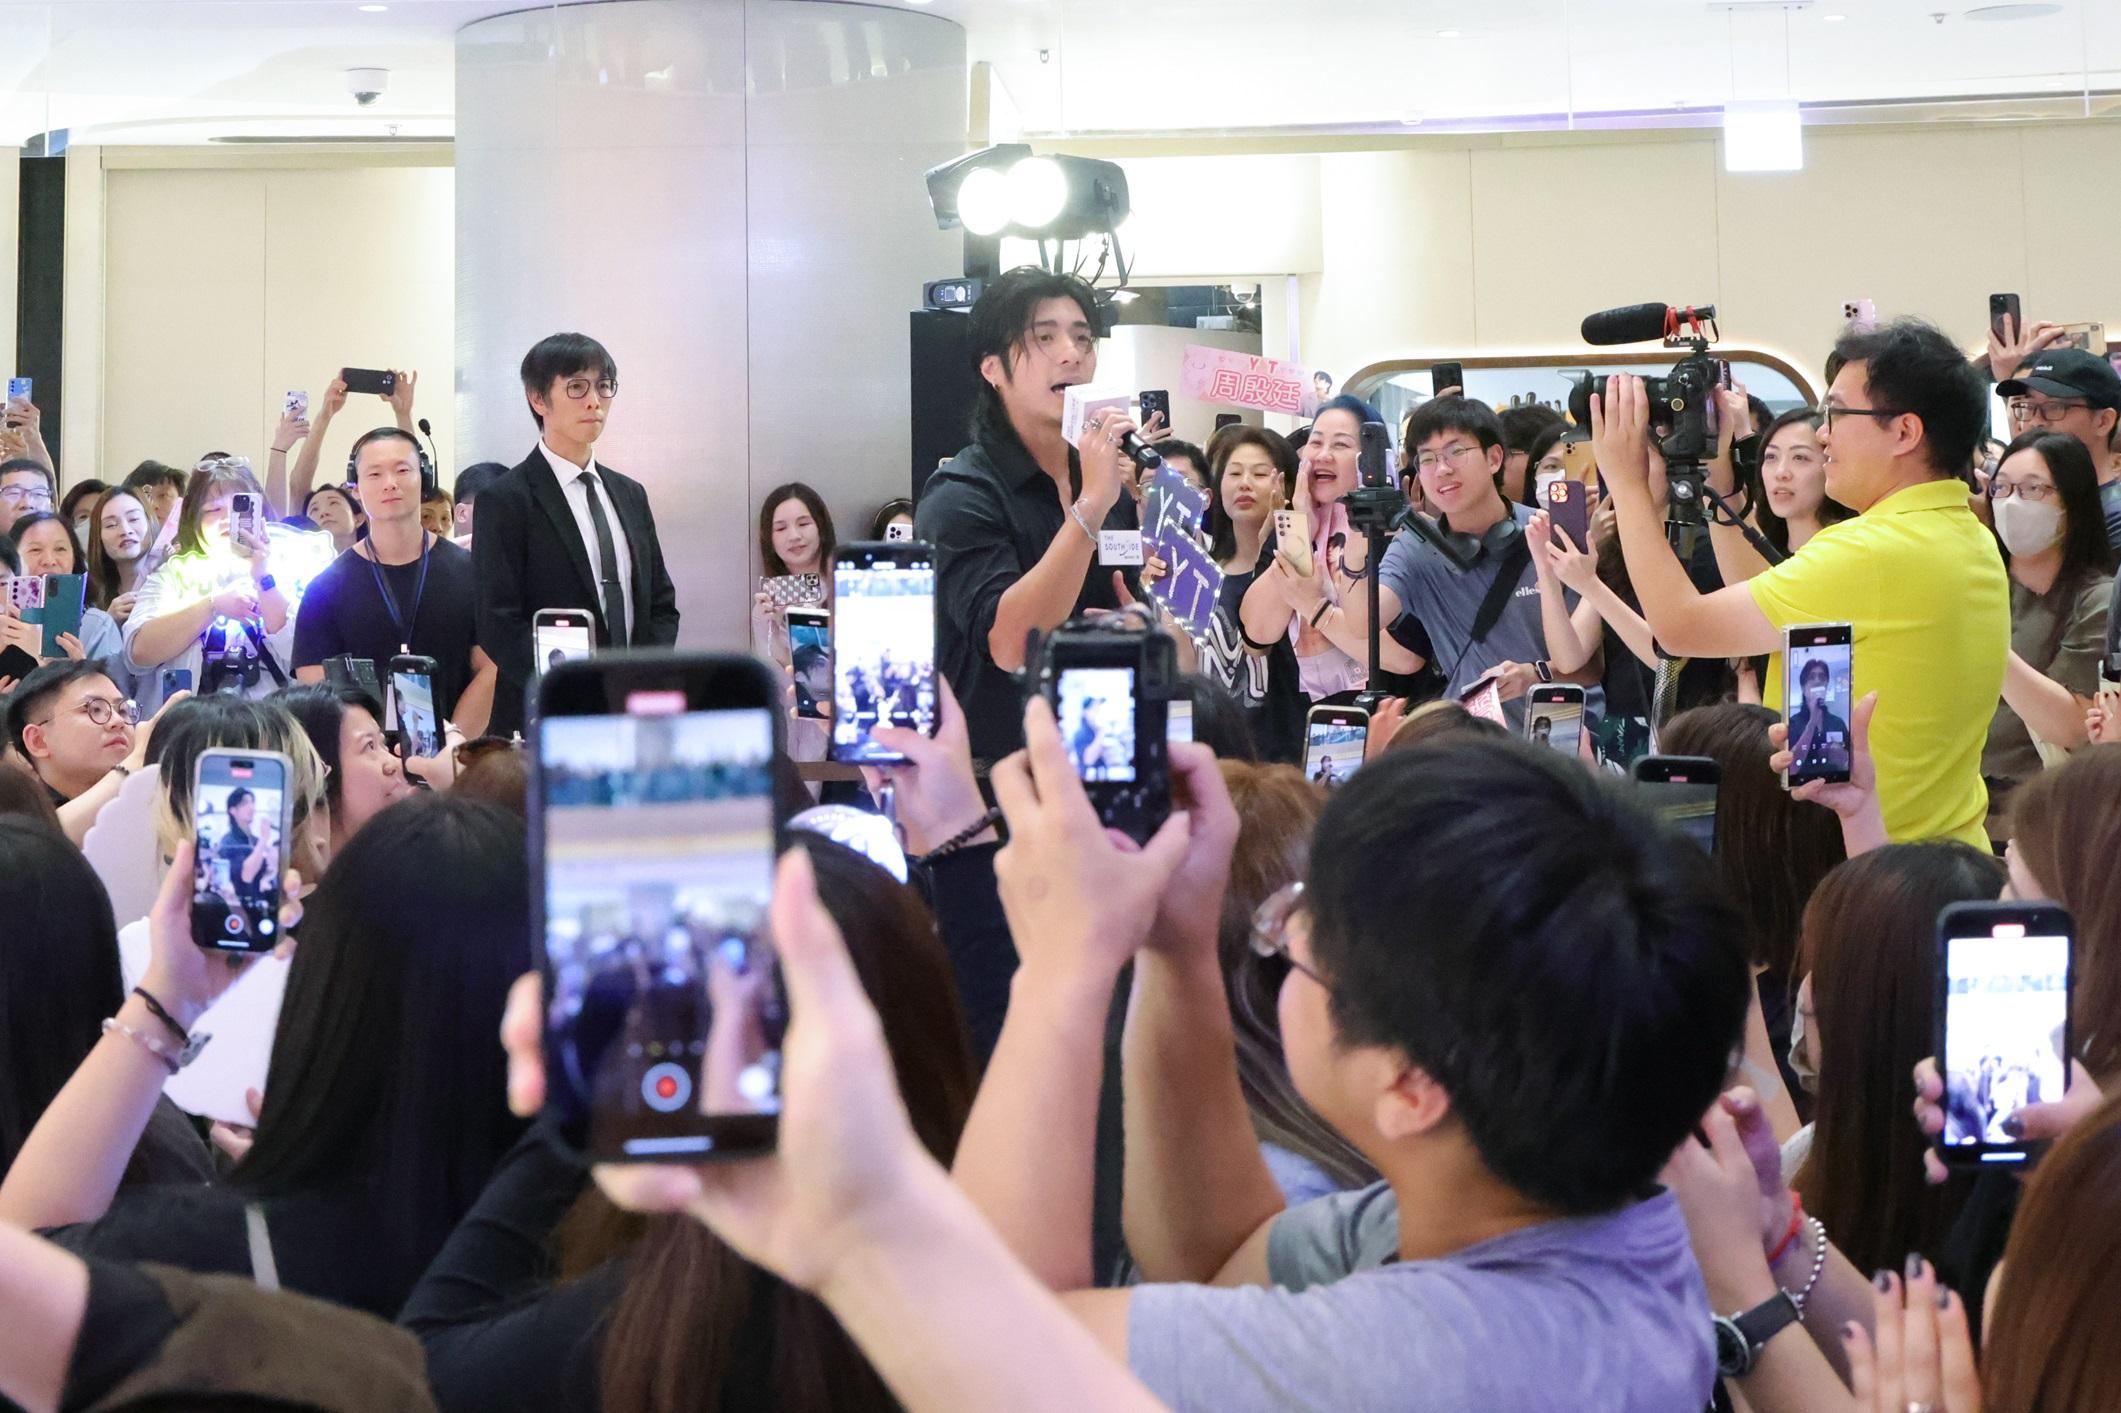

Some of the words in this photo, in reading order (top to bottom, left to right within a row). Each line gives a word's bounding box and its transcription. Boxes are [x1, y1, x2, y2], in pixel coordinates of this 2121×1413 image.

[1210, 369, 1300, 411] 周殷廷
[1169, 546, 1209, 621] YT
[1515, 586, 1537, 597] elle
